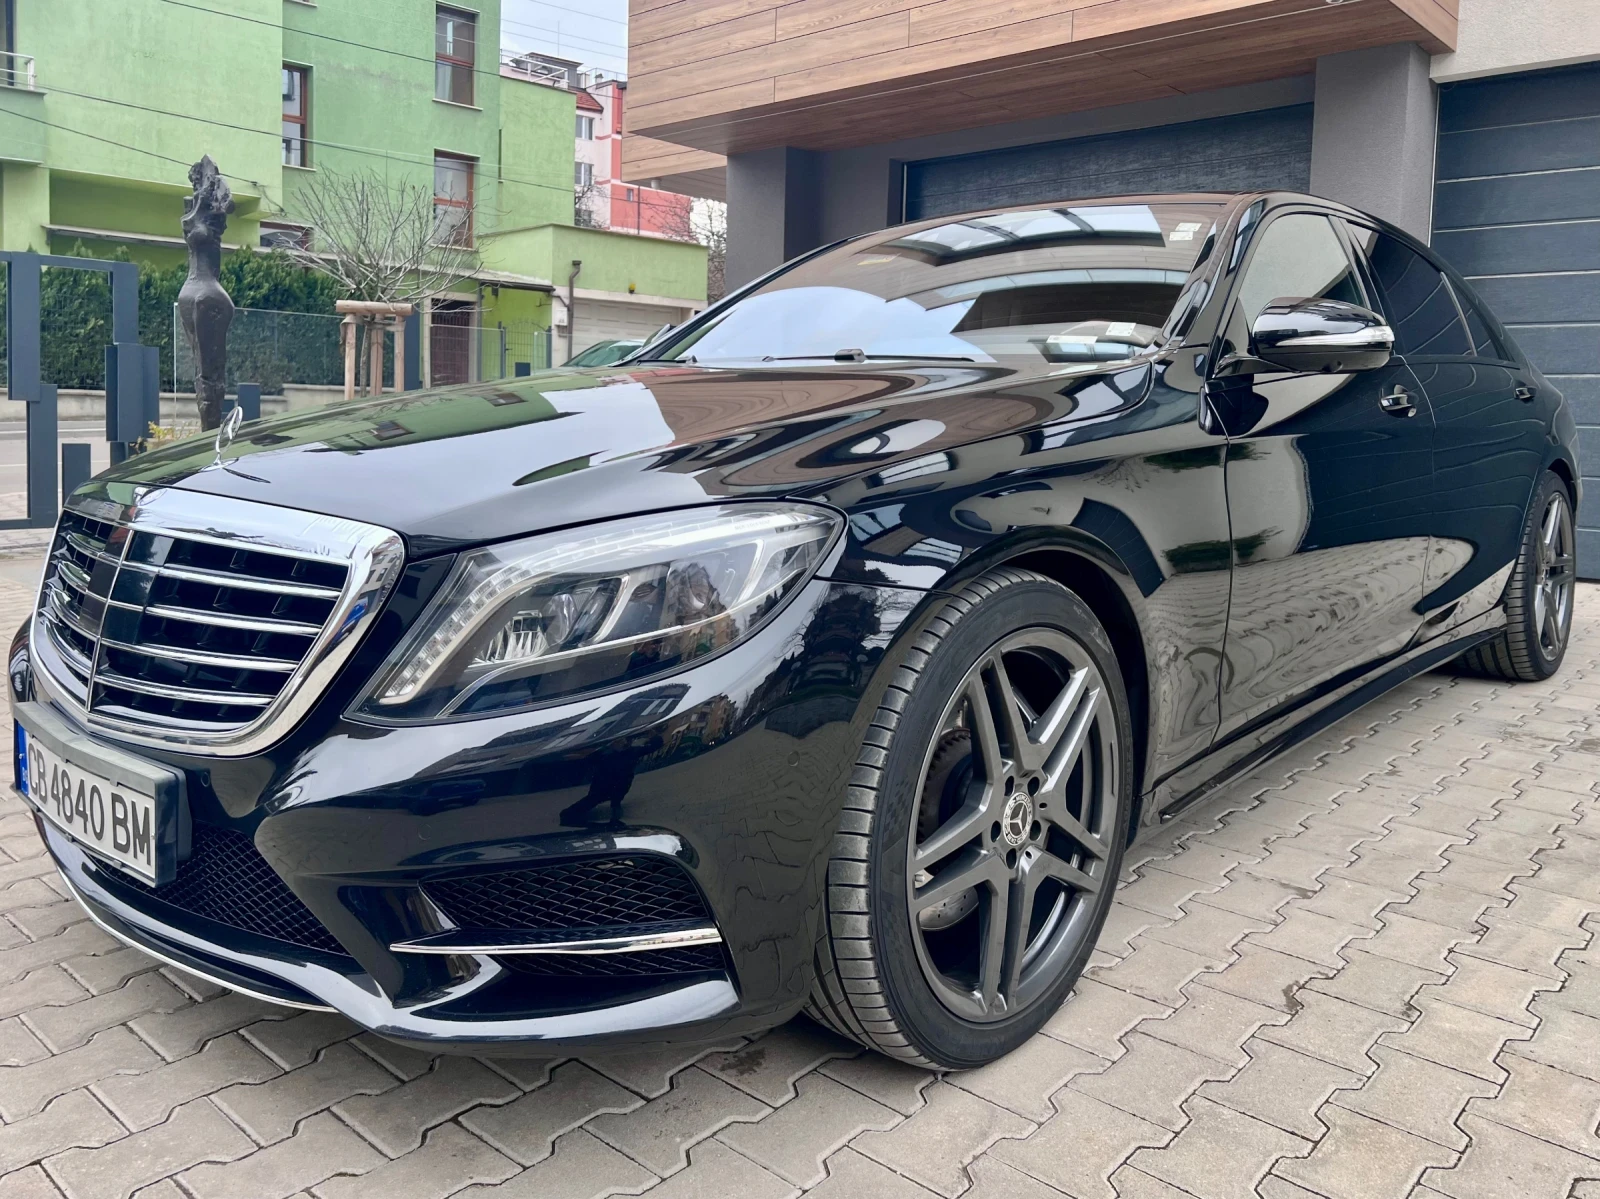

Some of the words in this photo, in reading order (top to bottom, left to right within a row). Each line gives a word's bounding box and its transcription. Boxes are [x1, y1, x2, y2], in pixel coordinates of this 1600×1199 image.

[28, 743, 48, 804] CB
[51, 763, 105, 841] 4840
[111, 792, 151, 866] BM
